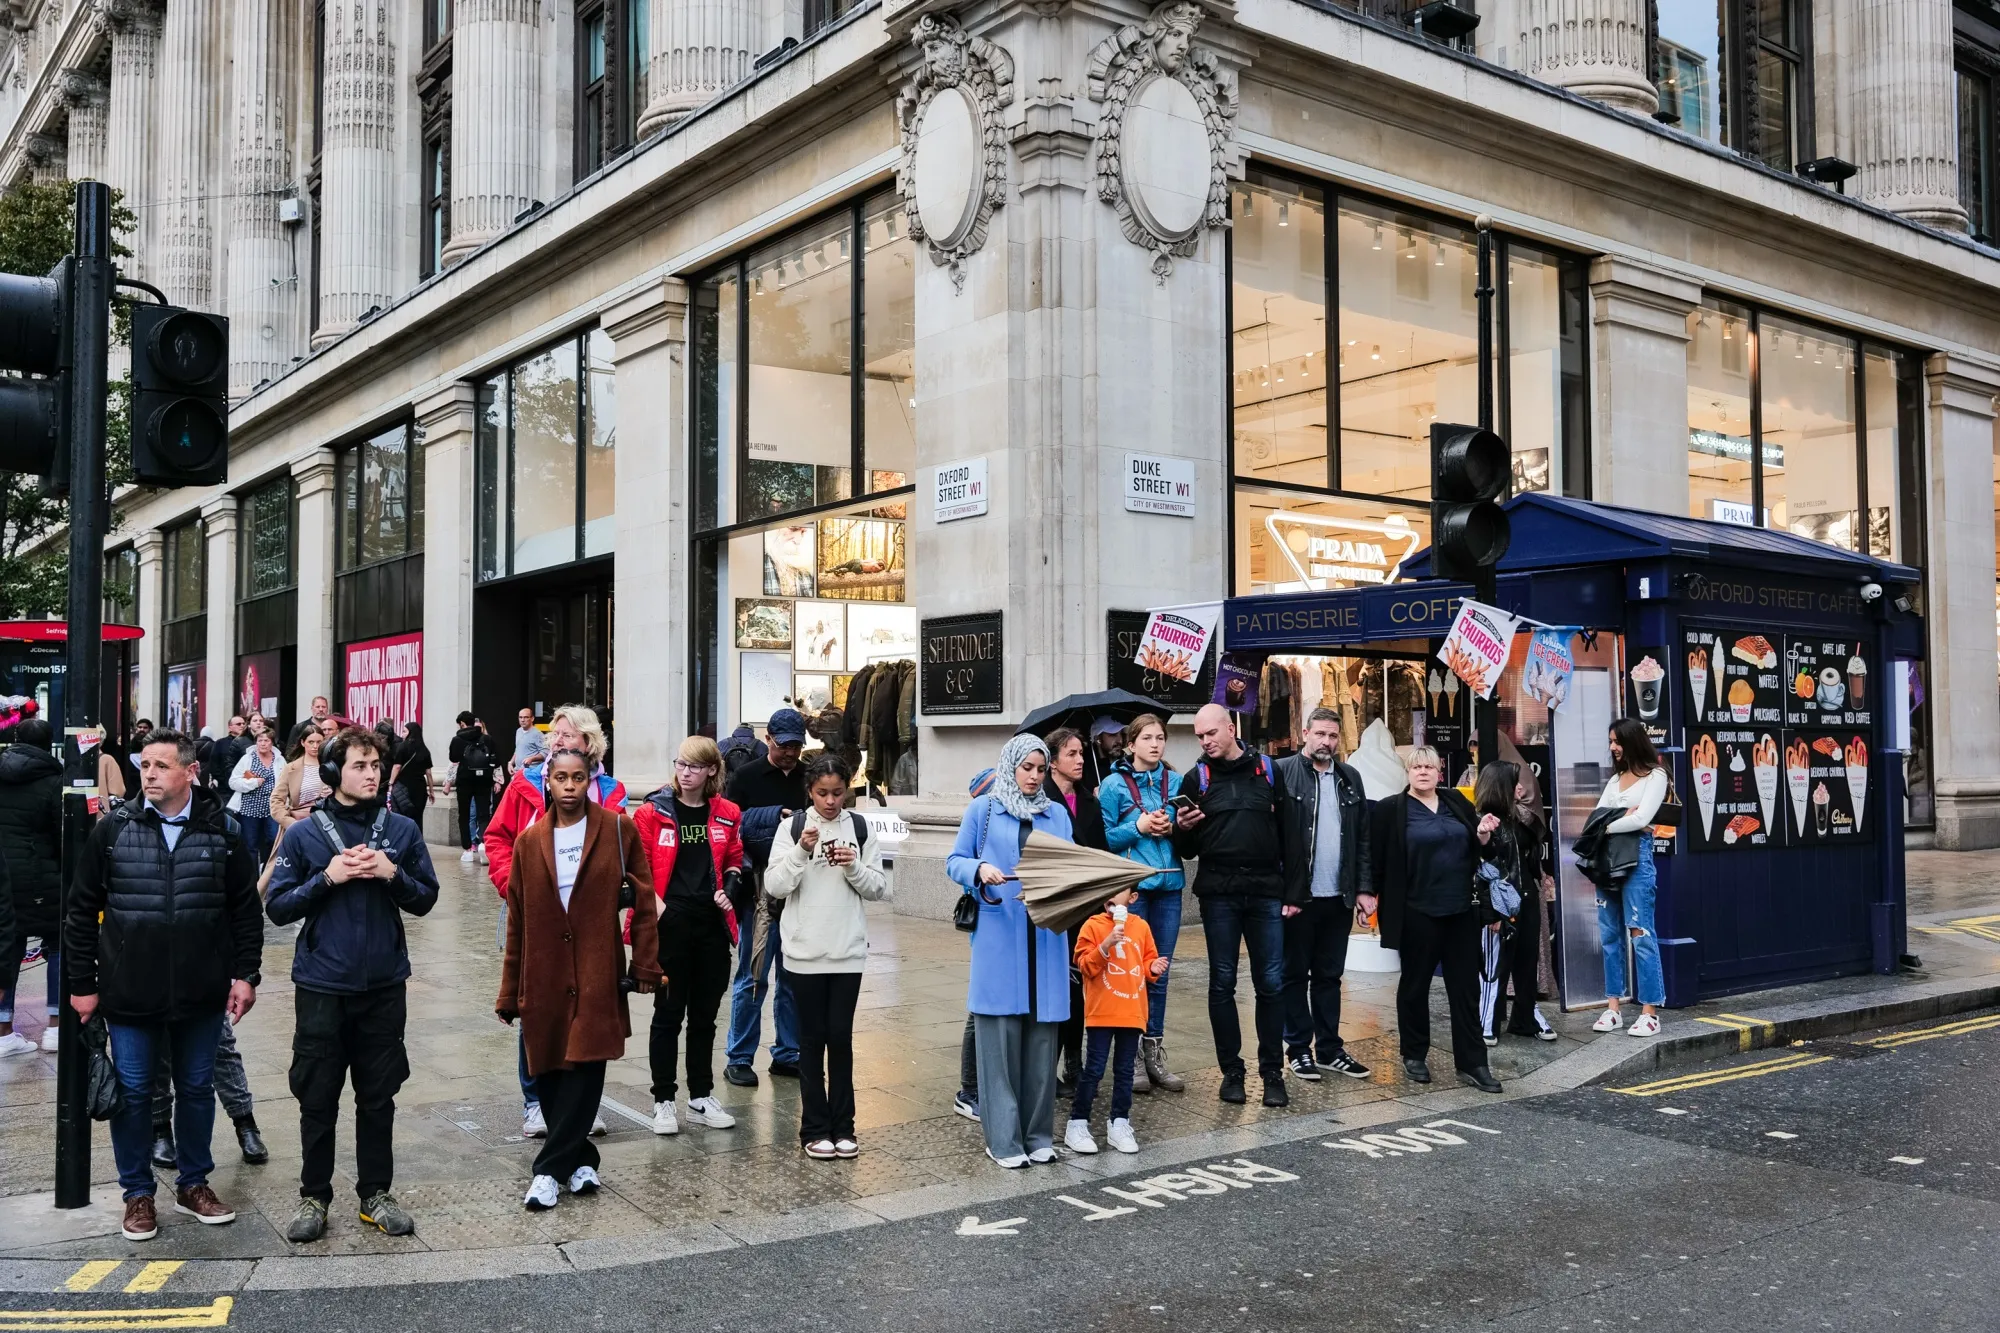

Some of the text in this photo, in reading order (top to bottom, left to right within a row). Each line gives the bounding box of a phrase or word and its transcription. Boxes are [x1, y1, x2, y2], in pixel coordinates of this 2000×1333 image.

[939, 467, 969, 486] OXFORD
[1133, 460, 1161, 476] DUKE
[939, 481, 981, 502] STREET W1
[1133, 477, 1189, 497] STREET W1
[952, 504, 978, 515] WESTMINSTER
[1133, 500, 1144, 508] CITY
[1153, 503, 1186, 512] WESTMINSTER
[1723, 508, 1753, 523] PRAD
[1308, 537, 1387, 565] PRADA
[1310, 563, 1385, 583] REPORTER
[1688, 581, 1863, 615] OXFORD STREET CAFFE
[1165, 614, 1200, 633] DELICIOUS
[1236, 607, 1359, 633] PATISSERIE
[1150, 622, 1204, 653] CHURROS
[1457, 616, 1505, 666] CHURROS
[1686, 632, 1699, 644] COLD
[928, 632, 995, 664] SELFRIDGE
[369, 648, 380, 682] FOR
[380, 647, 386, 680] A
[386, 641, 420, 680] CHRISTMAS
[1533, 642, 1570, 674] ICE CREAM
[19, 665, 50, 673] iPhone
[50, 665, 61, 673] 15
[1222, 663, 1258, 678] HOT CHOCOLATE
[945, 669, 956, 694] &
[1758, 675, 1779, 689] WAFFLES
[1707, 711, 1715, 722] ICE
[1716, 712, 1731, 723] CREAM
[1754, 708, 1781, 722] MILKSHAKES
[1788, 712, 1808, 724] BLACK TEA
[1844, 711, 1871, 724] ICED COFFEE
[1056, 1118, 1502, 1221] LOOK RIGHT
